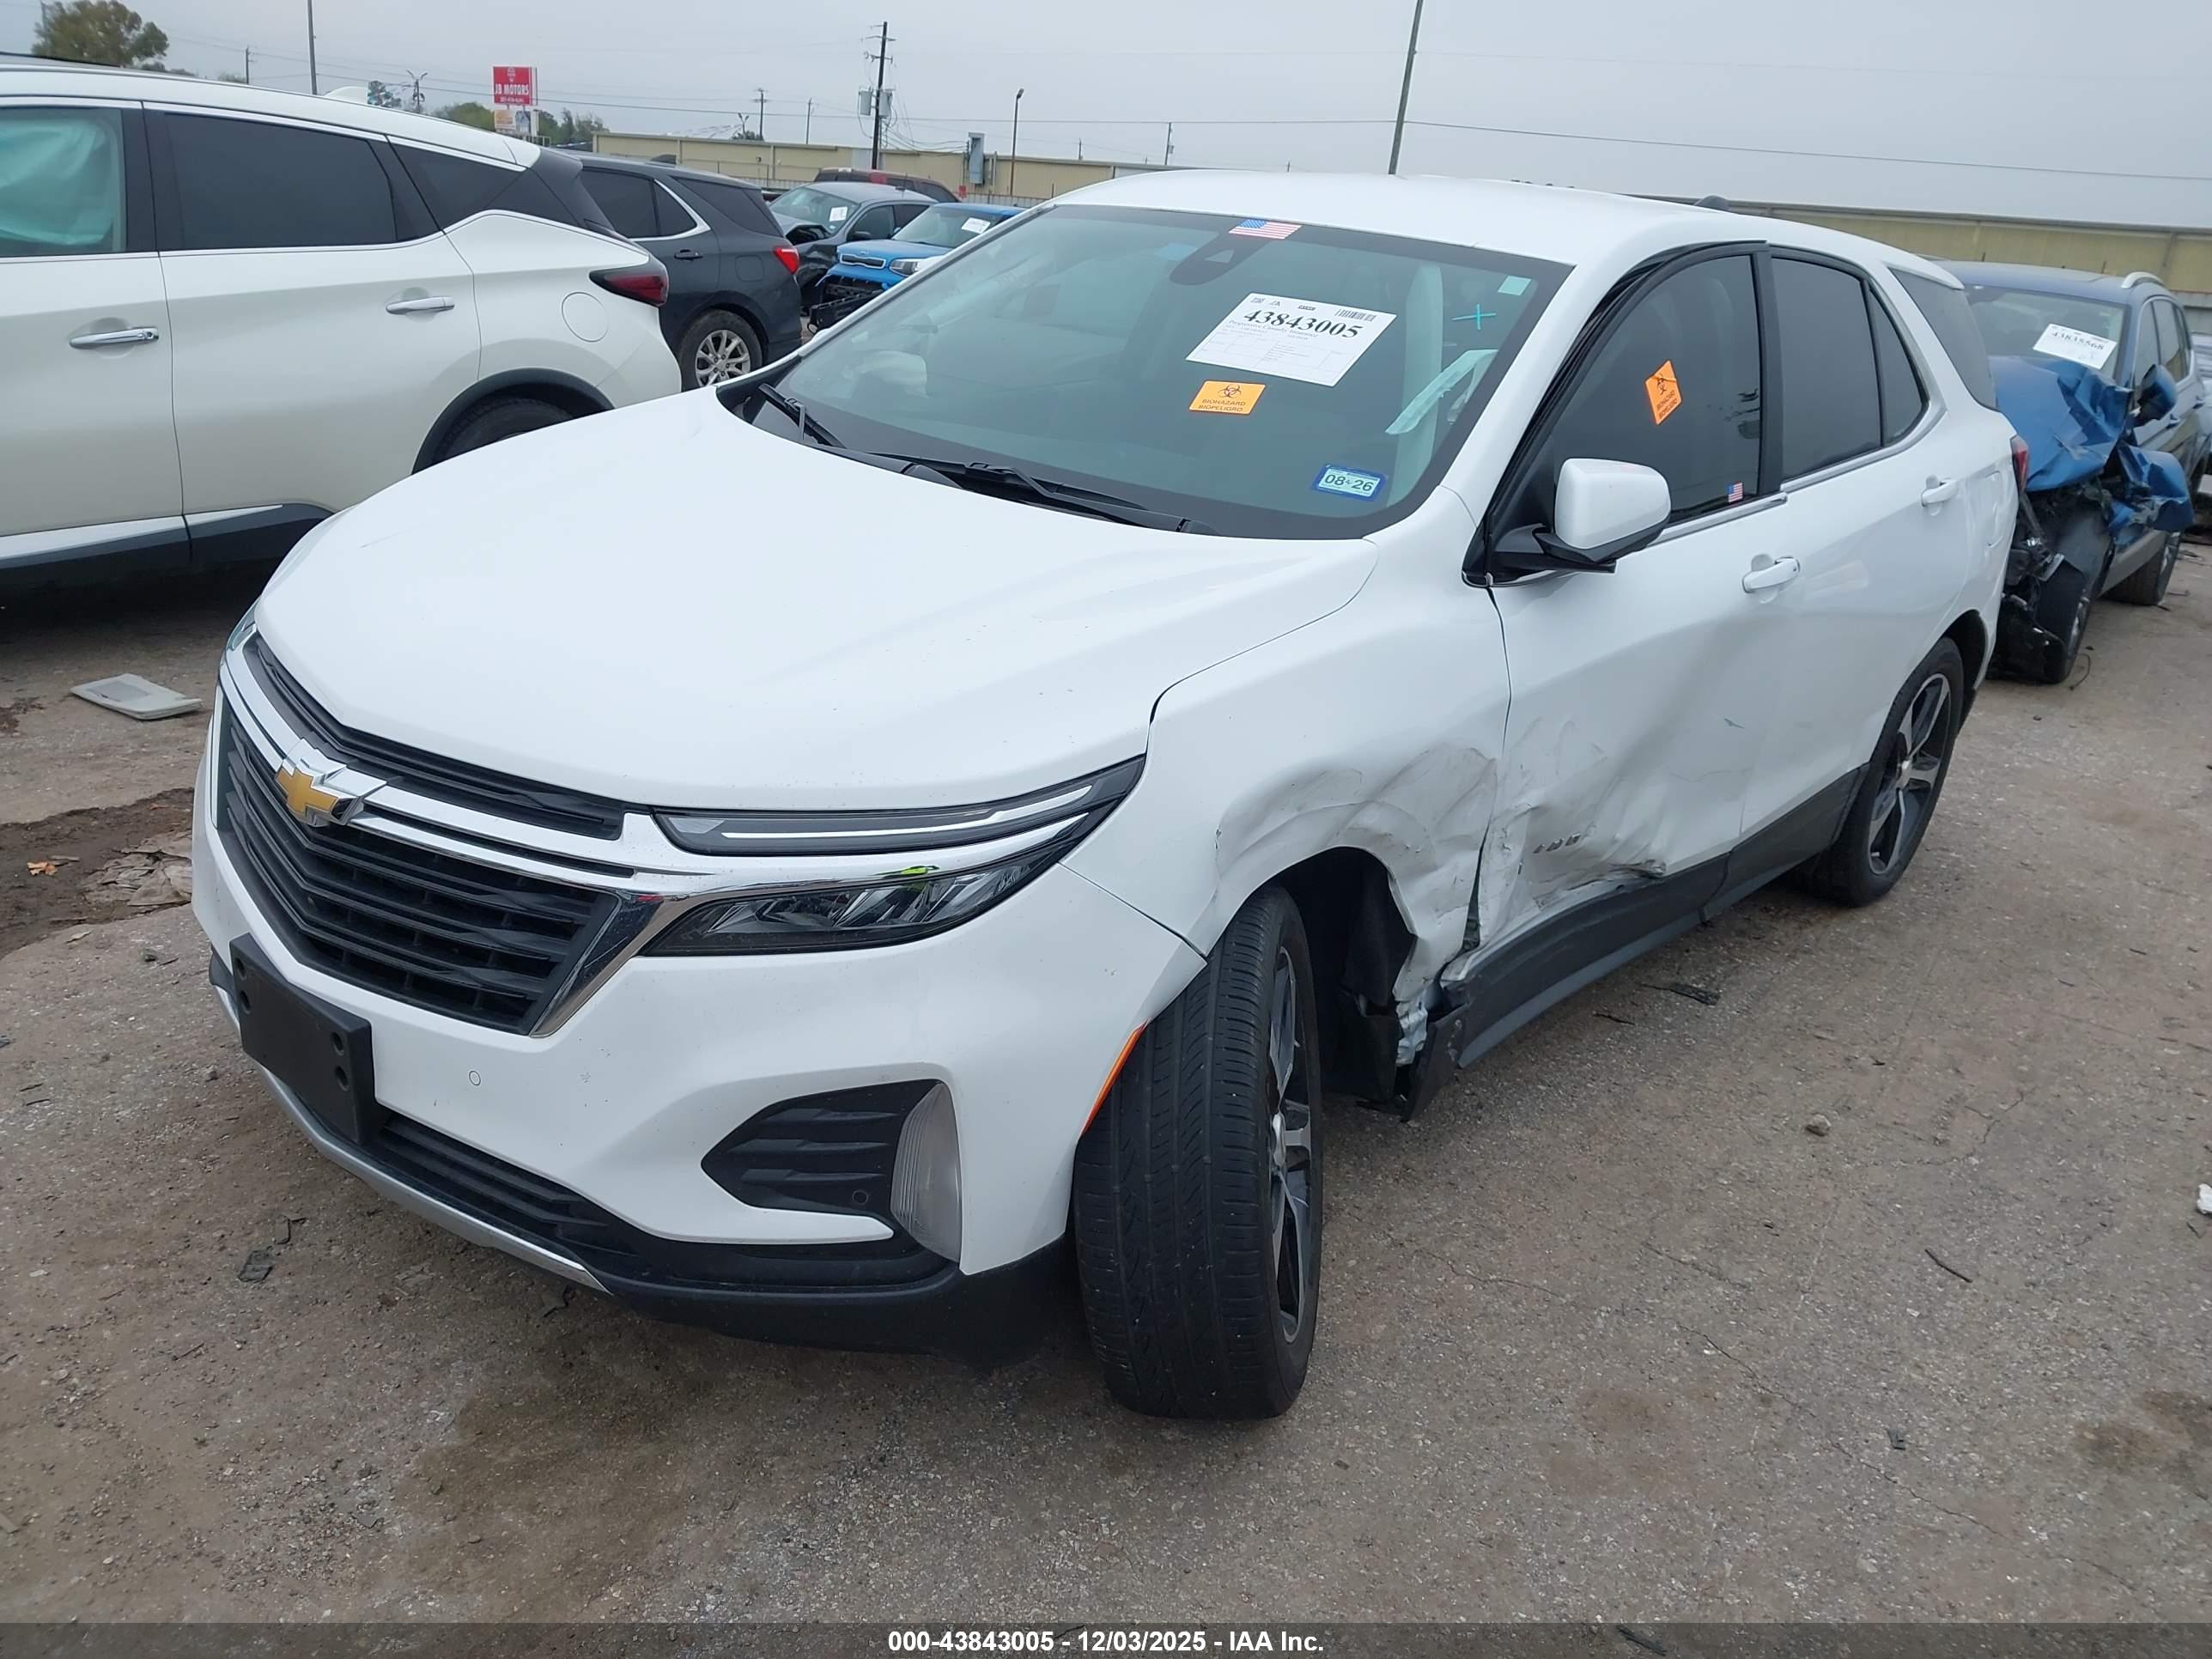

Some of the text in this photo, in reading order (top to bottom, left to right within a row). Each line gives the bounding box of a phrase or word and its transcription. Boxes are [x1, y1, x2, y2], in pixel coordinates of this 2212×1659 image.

[504, 83, 529, 95] MOTORS
[1244, 309, 1364, 339] 43843005
[1324, 474, 1346, 486] 08
[1352, 479, 1375, 492] 26
